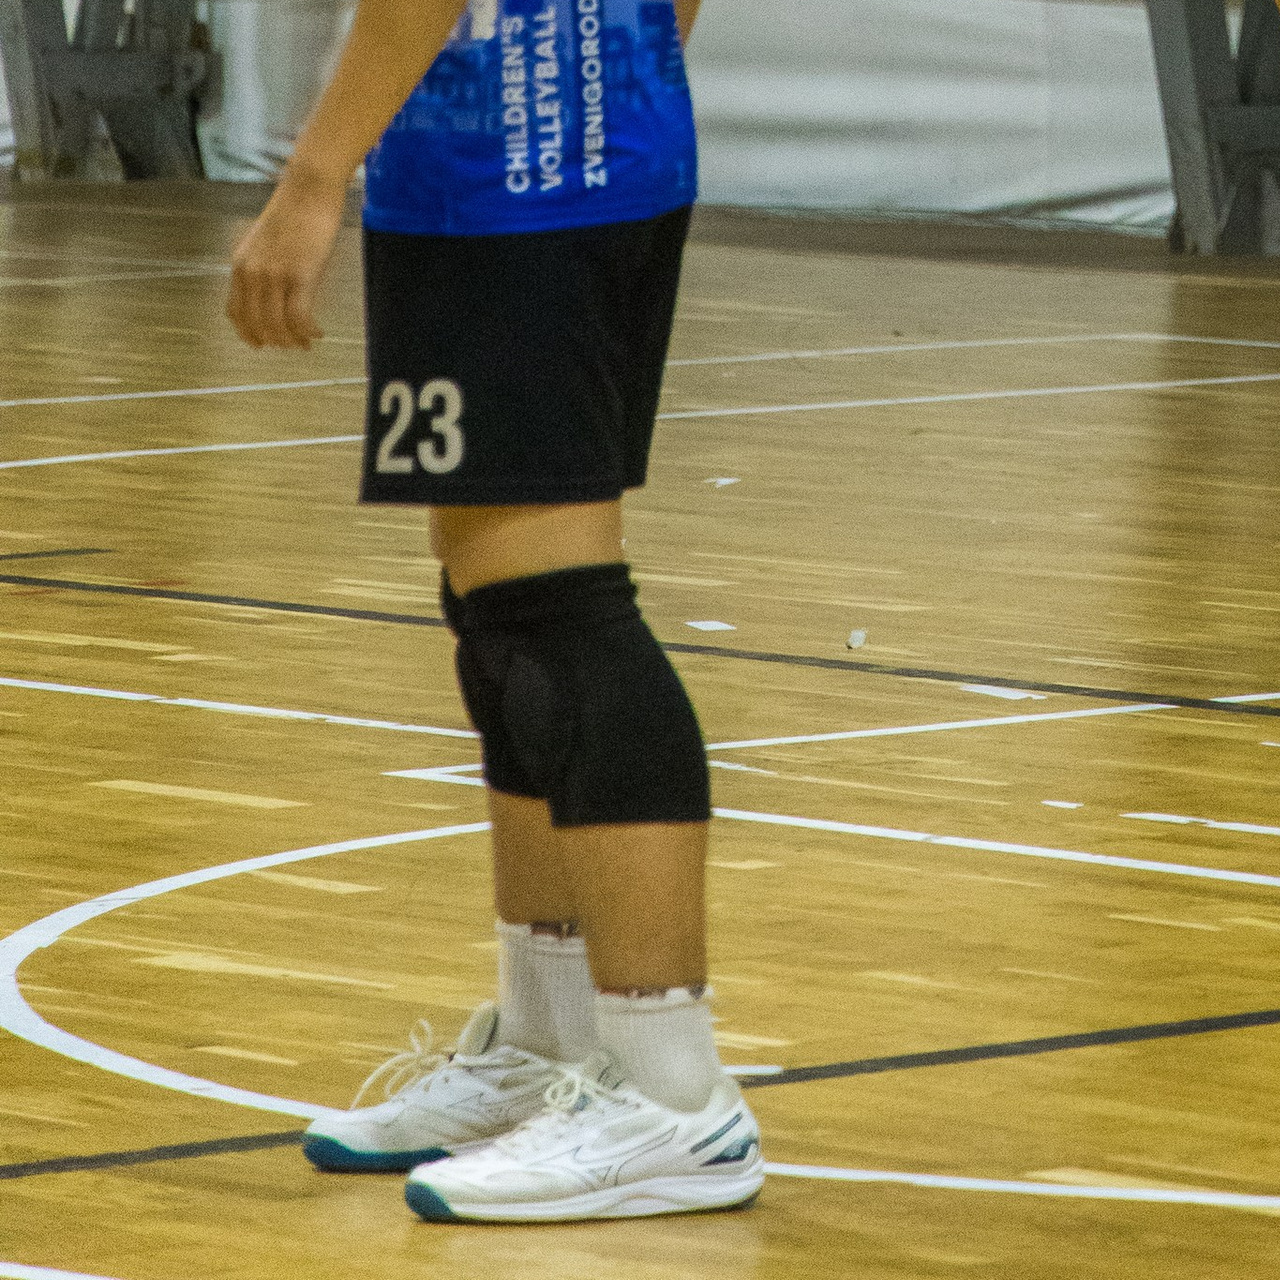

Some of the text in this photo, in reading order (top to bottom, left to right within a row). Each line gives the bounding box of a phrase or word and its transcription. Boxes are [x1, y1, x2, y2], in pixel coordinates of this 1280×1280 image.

[502, 15, 531, 194] CHILDREN'S
[531, 6, 563, 192] VOLLEYBALL
[376, 377, 465, 474] 23
